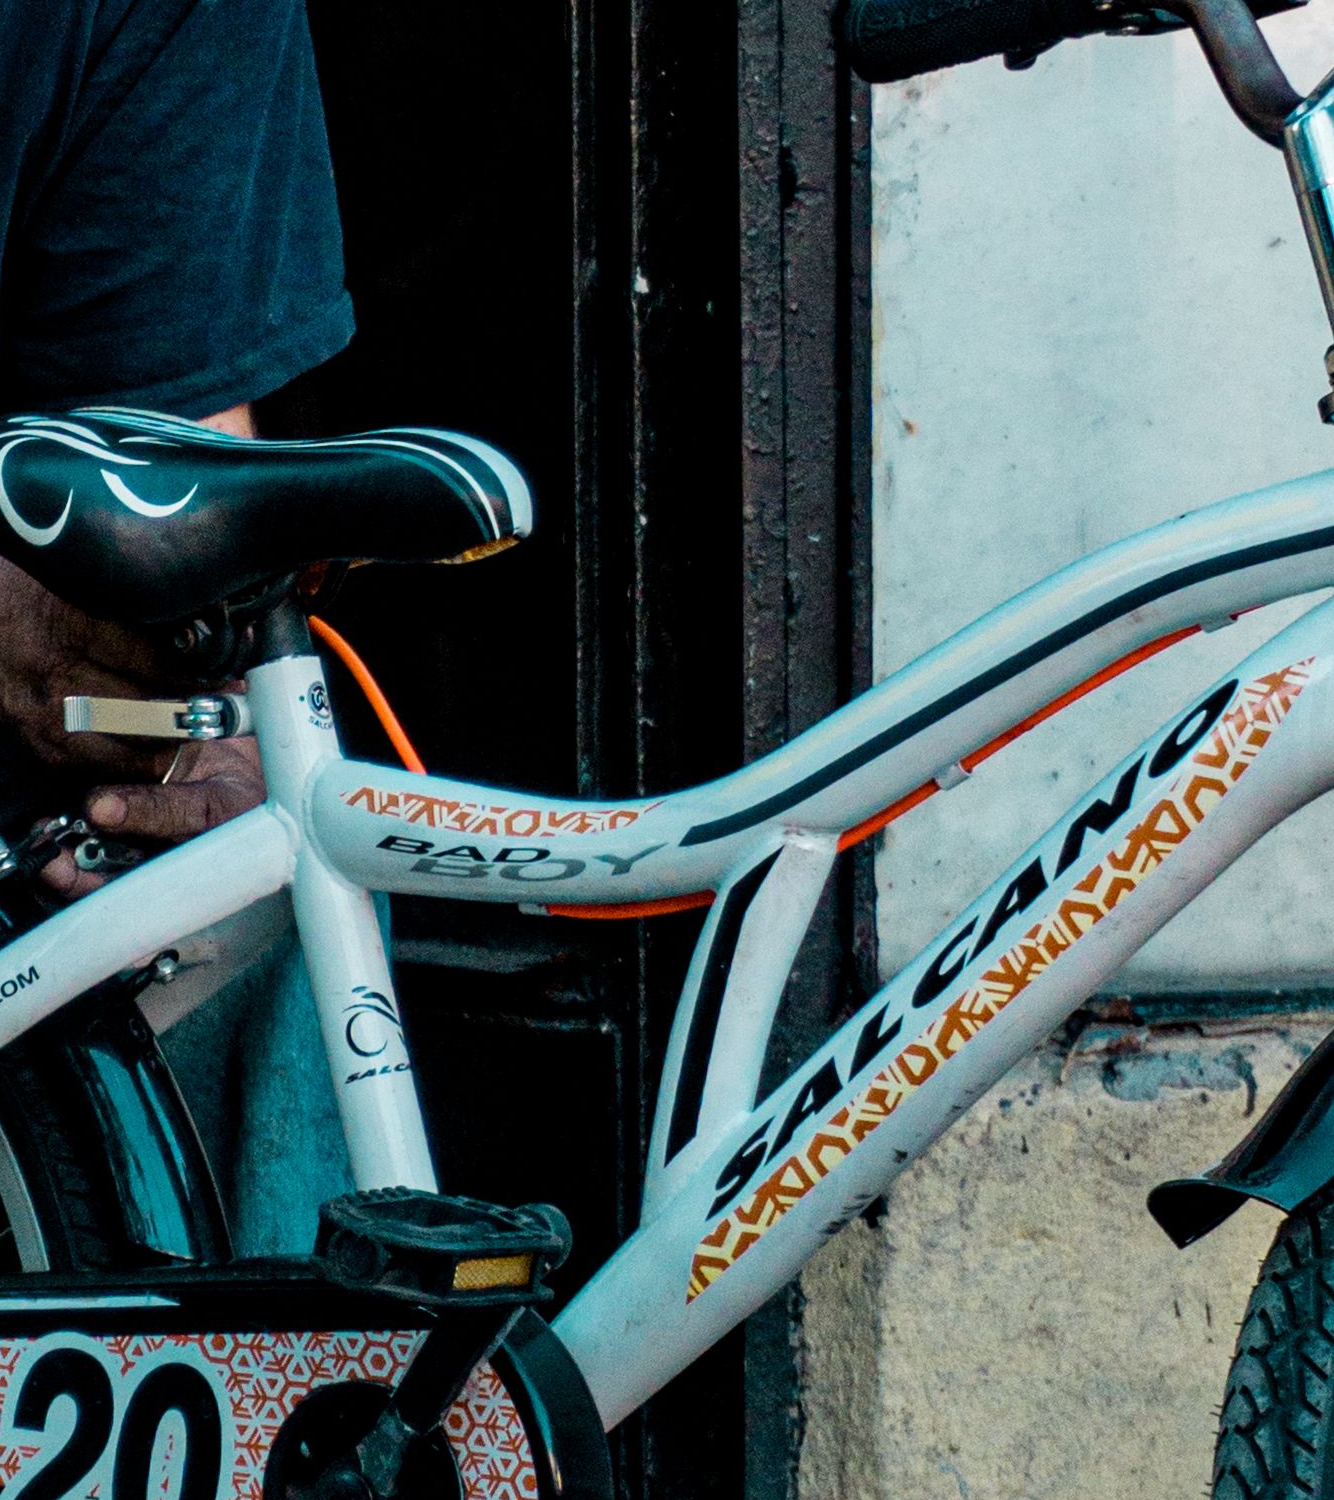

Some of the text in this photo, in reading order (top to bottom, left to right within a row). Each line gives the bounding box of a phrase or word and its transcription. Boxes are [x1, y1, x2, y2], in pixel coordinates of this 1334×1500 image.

[376, 835, 669, 883] BAD BOY
[706, 679, 1238, 1221] SALCANO
